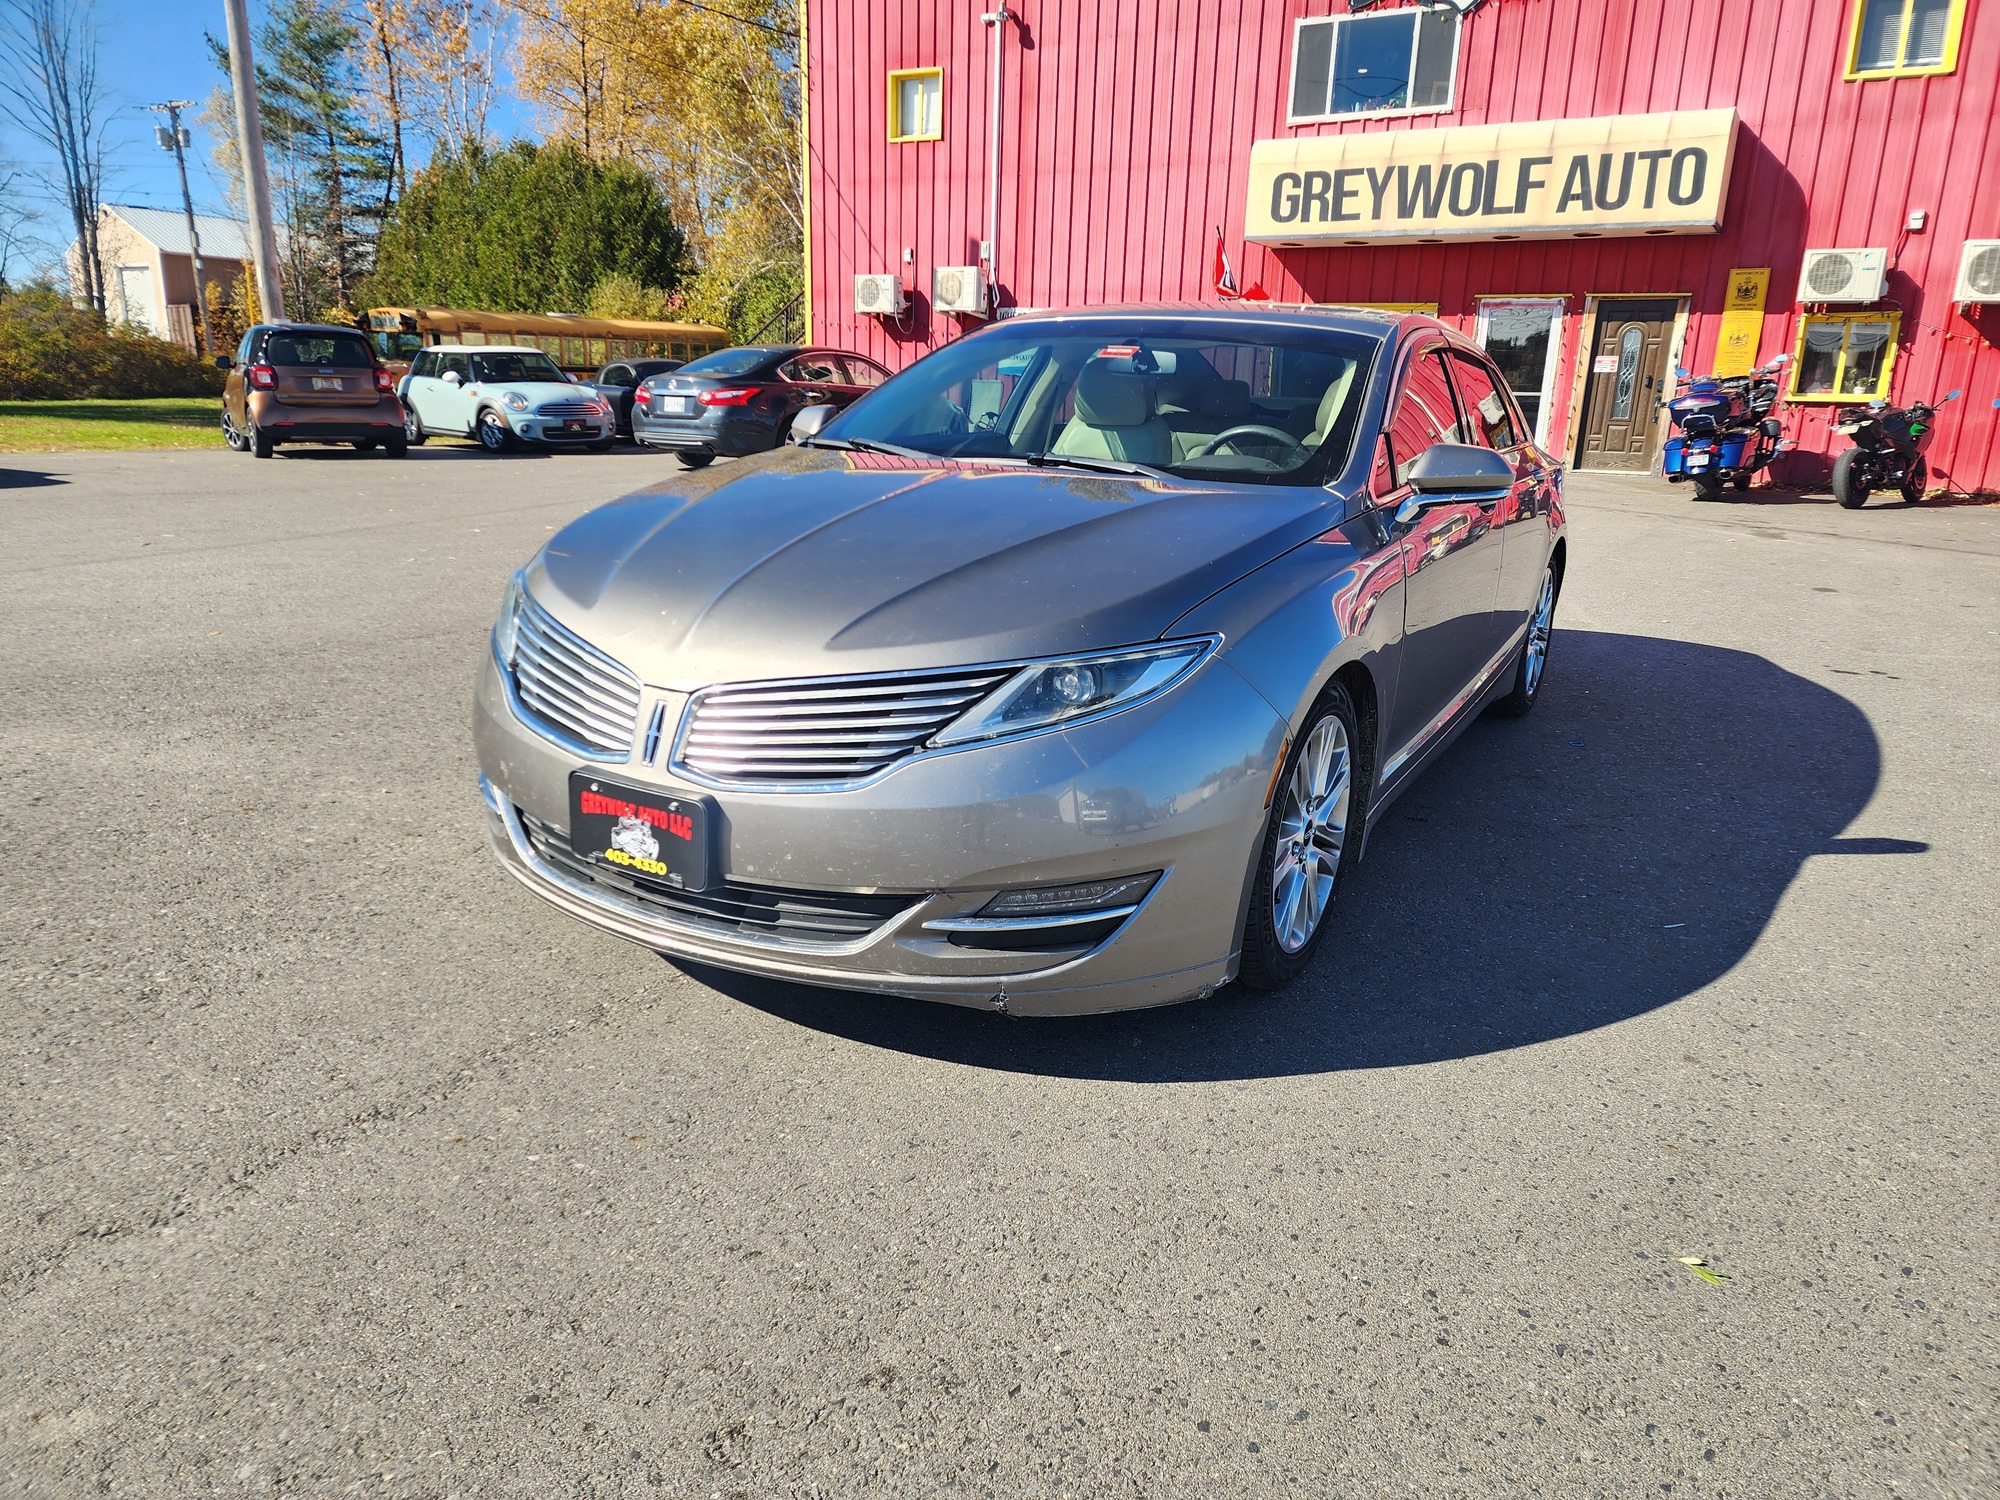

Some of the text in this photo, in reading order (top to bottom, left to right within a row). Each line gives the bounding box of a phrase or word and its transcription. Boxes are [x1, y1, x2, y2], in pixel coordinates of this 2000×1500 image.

[1271, 146, 1708, 223] GREYWOLF AUTO
[637, 805, 669, 830] AUTO
[669, 813, 693, 841] LLC
[604, 849, 667, 875] 403-4330
